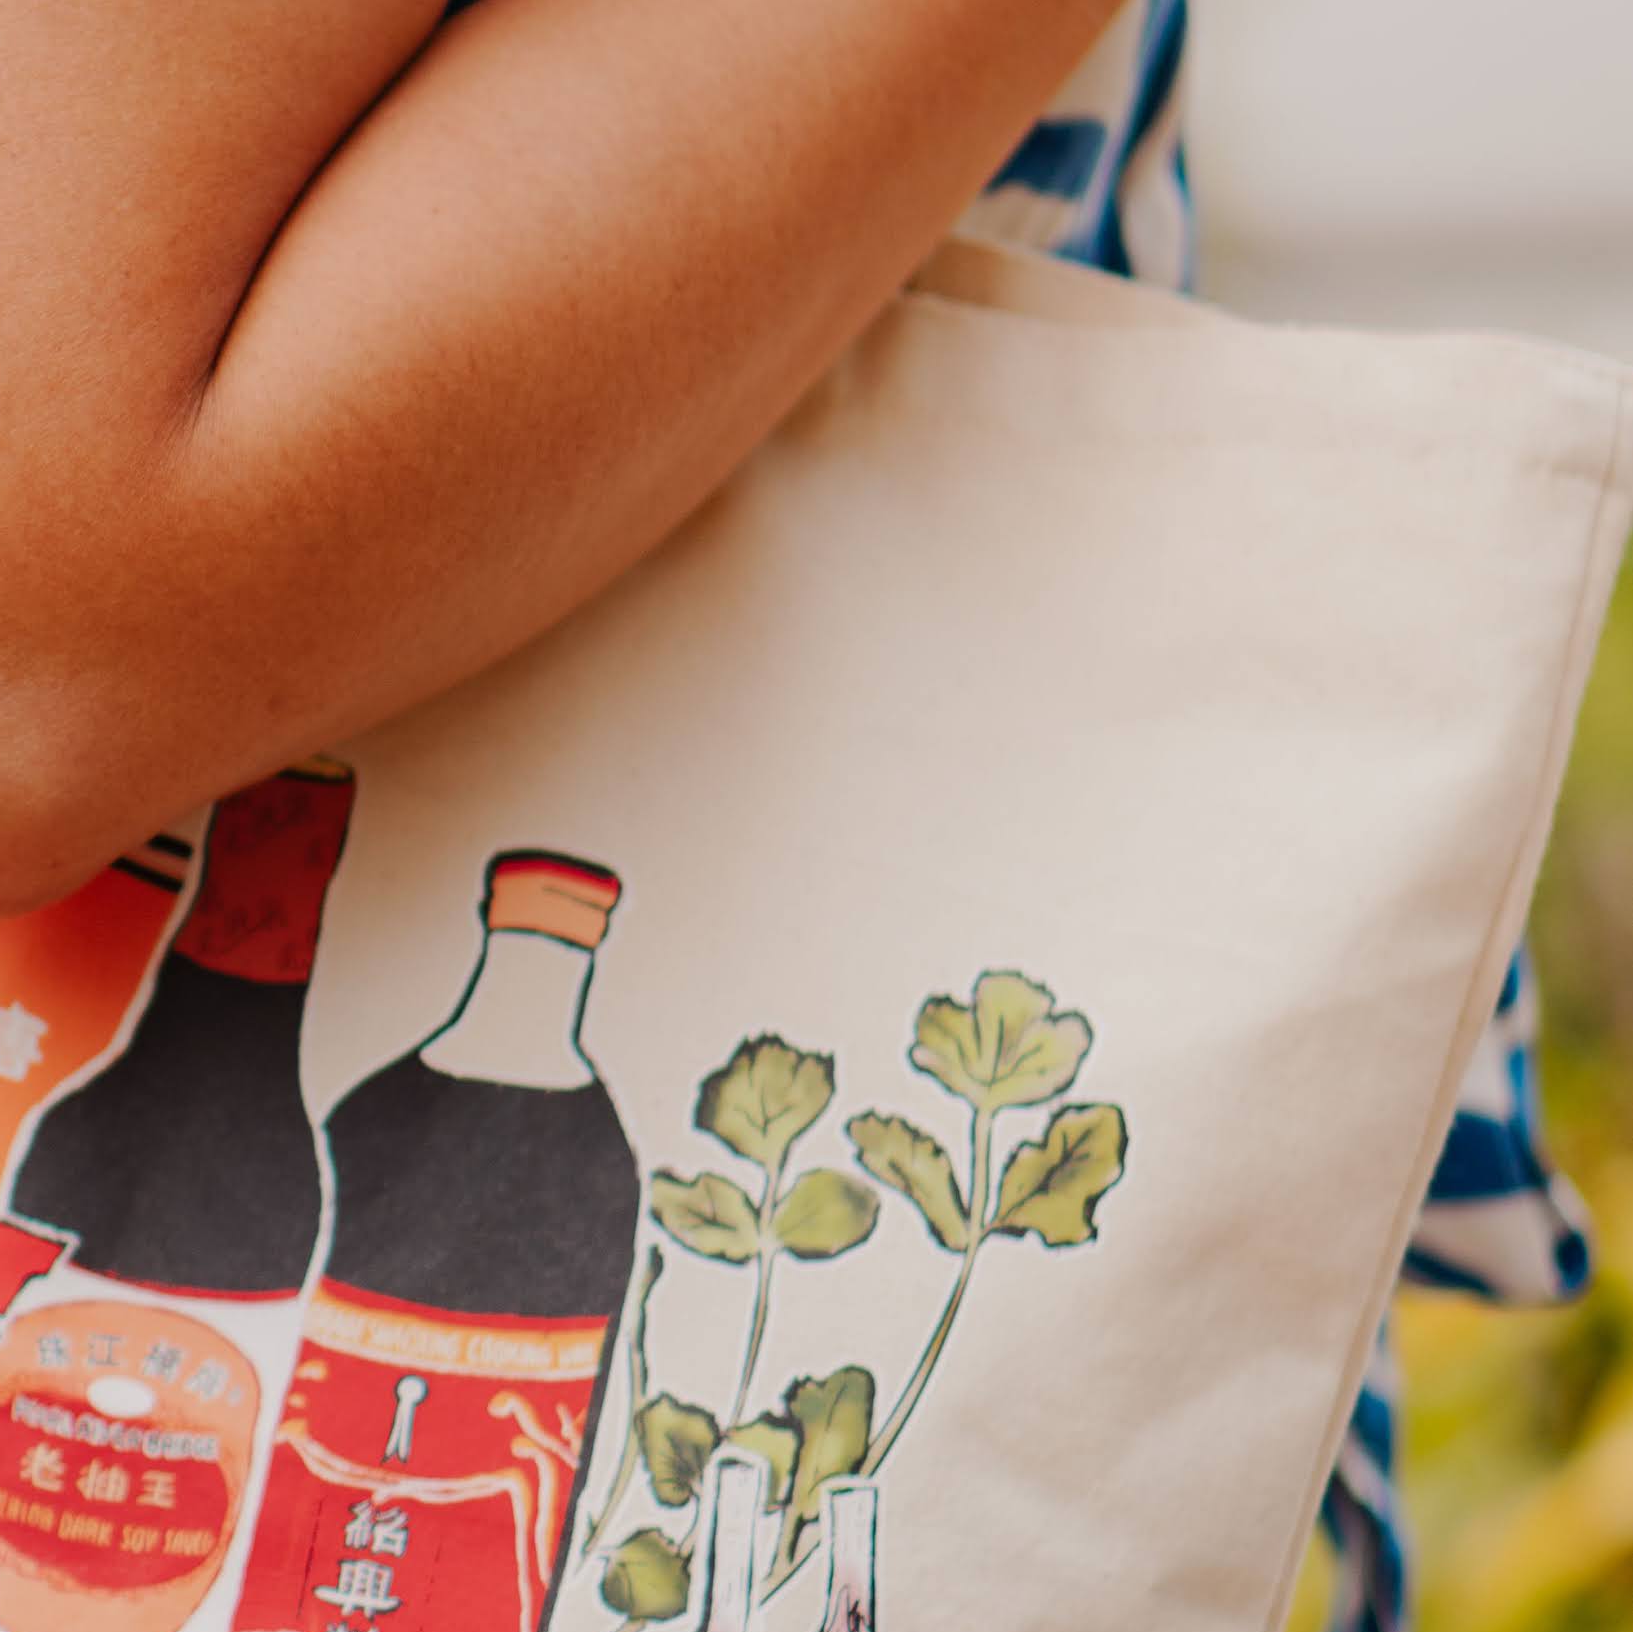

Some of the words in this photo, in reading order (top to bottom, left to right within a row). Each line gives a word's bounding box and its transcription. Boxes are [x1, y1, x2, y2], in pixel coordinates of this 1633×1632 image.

[20, 1442, 177, 1510] 老抽王
[120, 1524, 160, 1554] SOY
